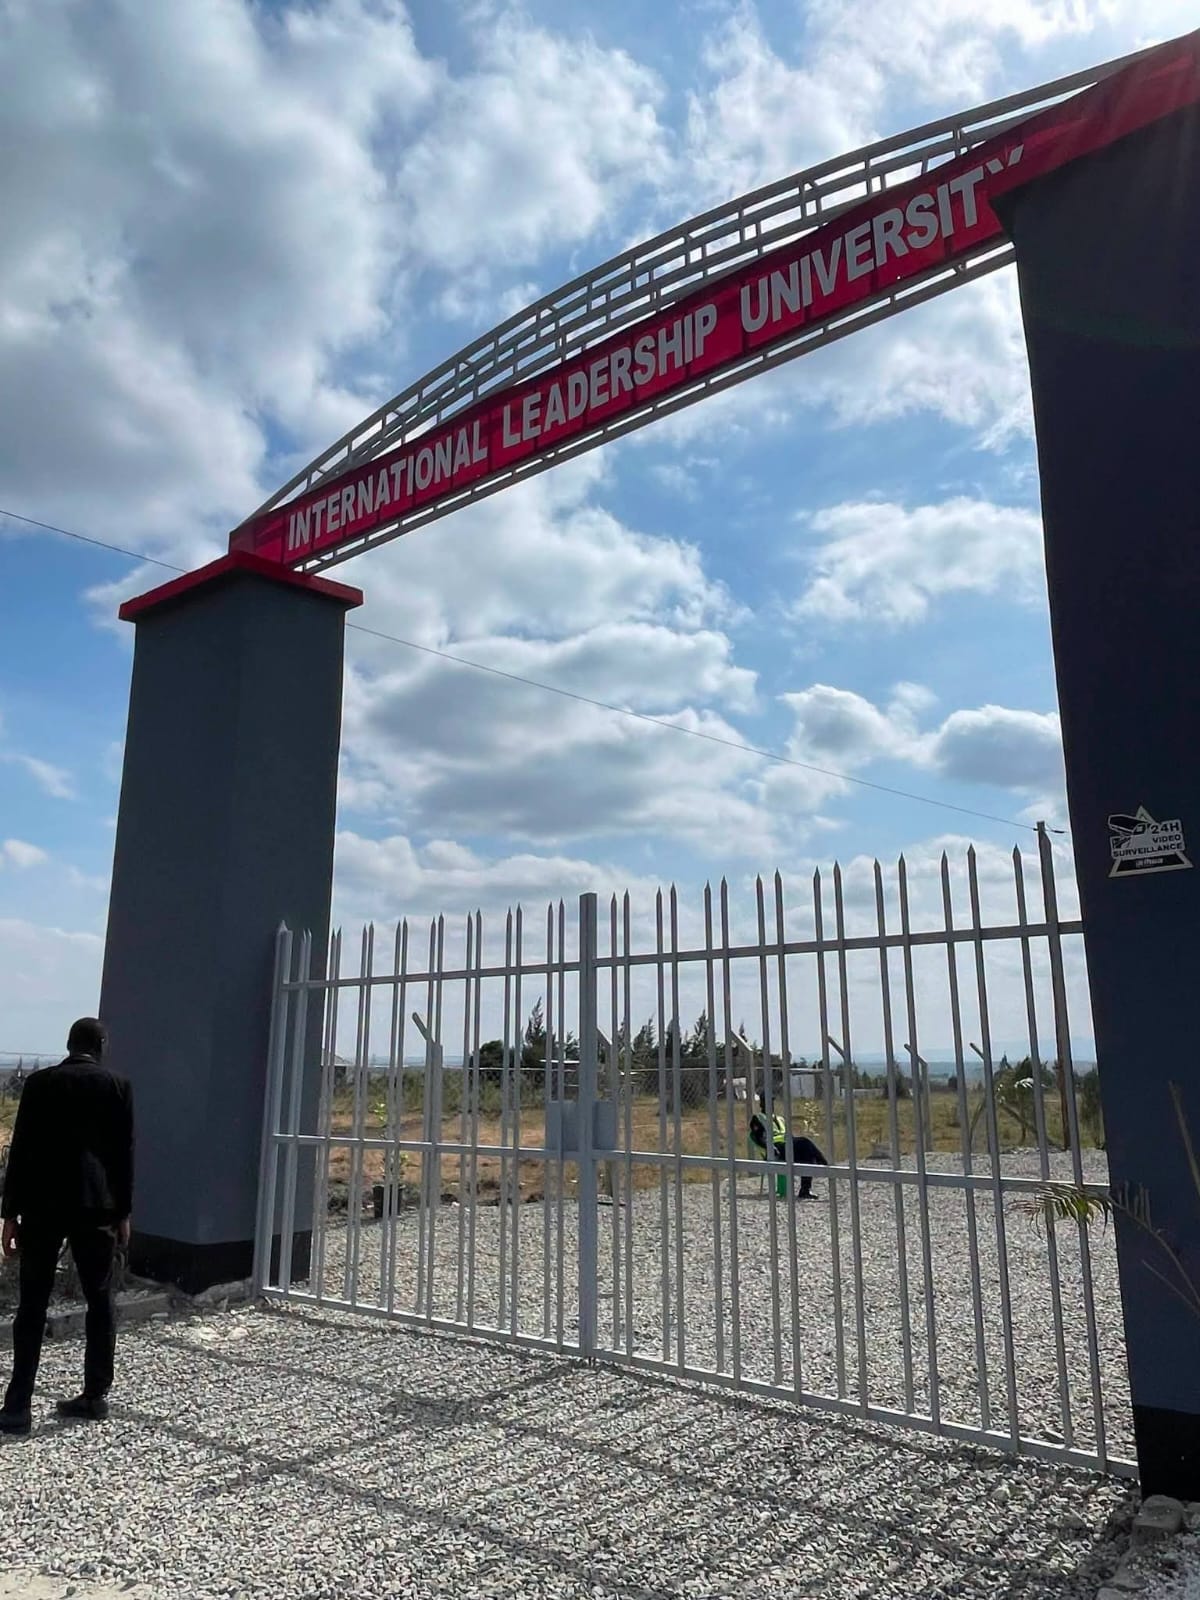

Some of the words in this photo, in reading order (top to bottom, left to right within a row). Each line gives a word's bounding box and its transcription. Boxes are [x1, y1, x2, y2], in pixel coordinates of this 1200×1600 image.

[288, 420, 488, 550] INTERNATIONAL
[502, 303, 717, 447] LEADERSHIP
[1150, 821, 1180, 834] 24H
[1152, 834, 1181, 843] VIDEO
[1113, 842, 1183, 857] SURVEILLANCE
